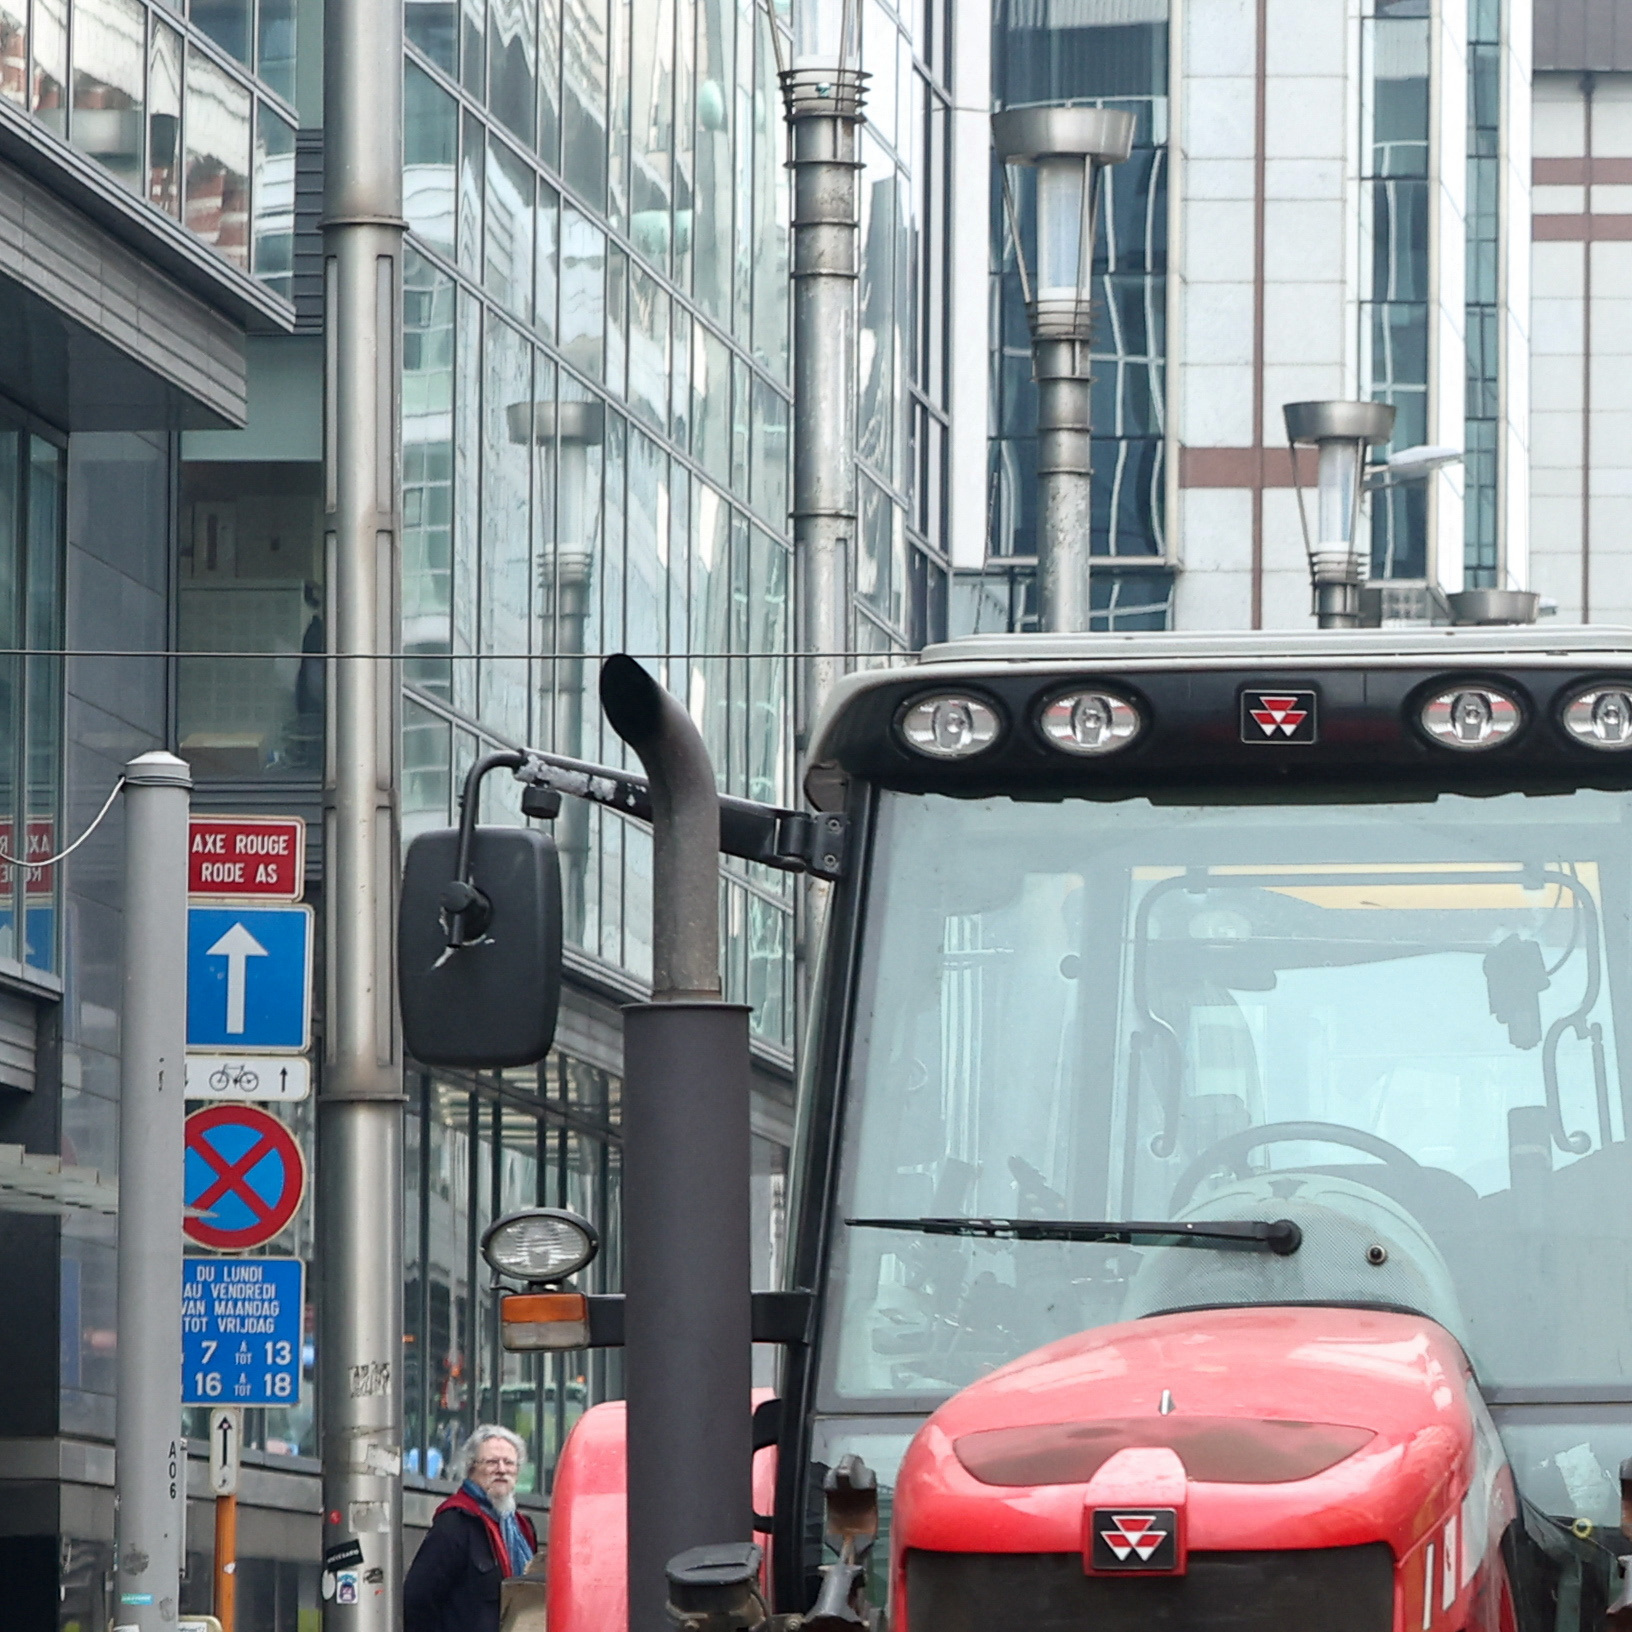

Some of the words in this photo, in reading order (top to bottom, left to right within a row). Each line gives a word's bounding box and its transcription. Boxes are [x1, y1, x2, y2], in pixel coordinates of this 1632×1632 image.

[191, 833, 227, 854] AXE
[235, 834, 289, 856] ROUGE
[201, 862, 245, 883] RODE
[255, 863, 278, 884] AS
[196, 1266, 215, 1282] DU
[223, 1266, 263, 1282] LUNDI
[183, 1283, 202, 1299] AU
[210, 1283, 276, 1299] VENDREDI
[214, 1300, 280, 1317] MAANDAG
[183, 1317, 209, 1333] TOT
[217, 1317, 275, 1334] VRIJDAG
[201, 1340, 218, 1365] 7
[264, 1340, 292, 1366] 13
[195, 1372, 223, 1397] 16
[263, 1372, 292, 1397] 18
